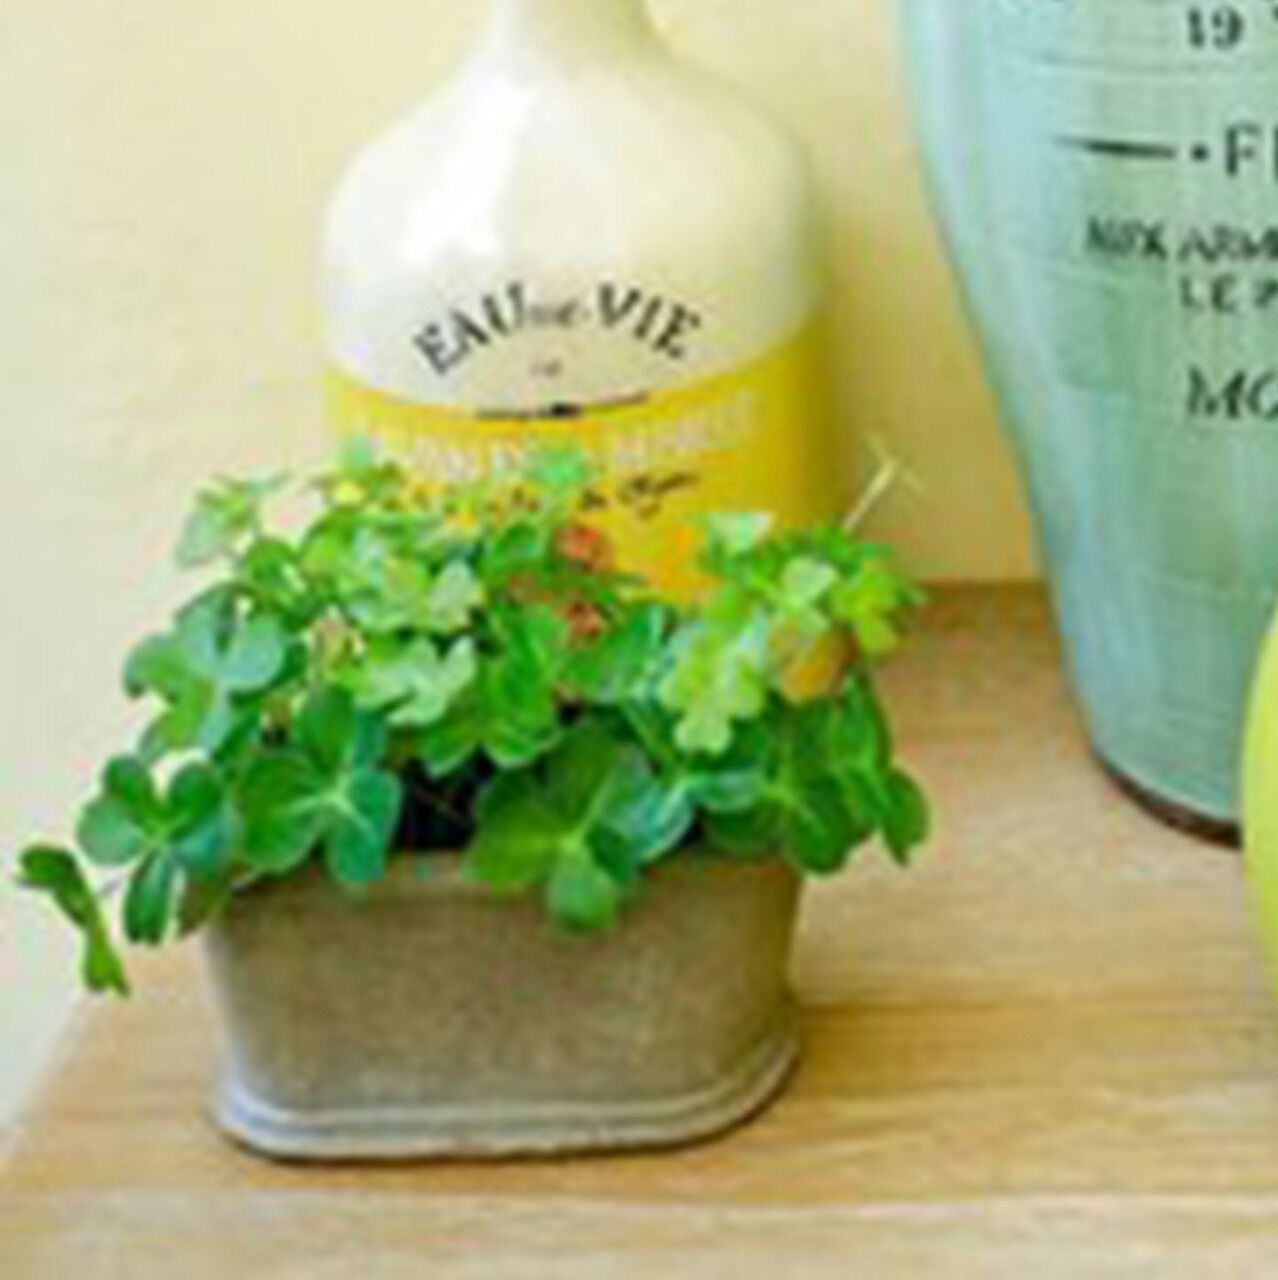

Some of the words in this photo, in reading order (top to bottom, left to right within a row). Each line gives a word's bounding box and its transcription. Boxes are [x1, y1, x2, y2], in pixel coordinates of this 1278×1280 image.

[1186, 5, 1246, 51] 19
[412, 281, 525, 376] EAU
[599, 282, 702, 360] VIE
